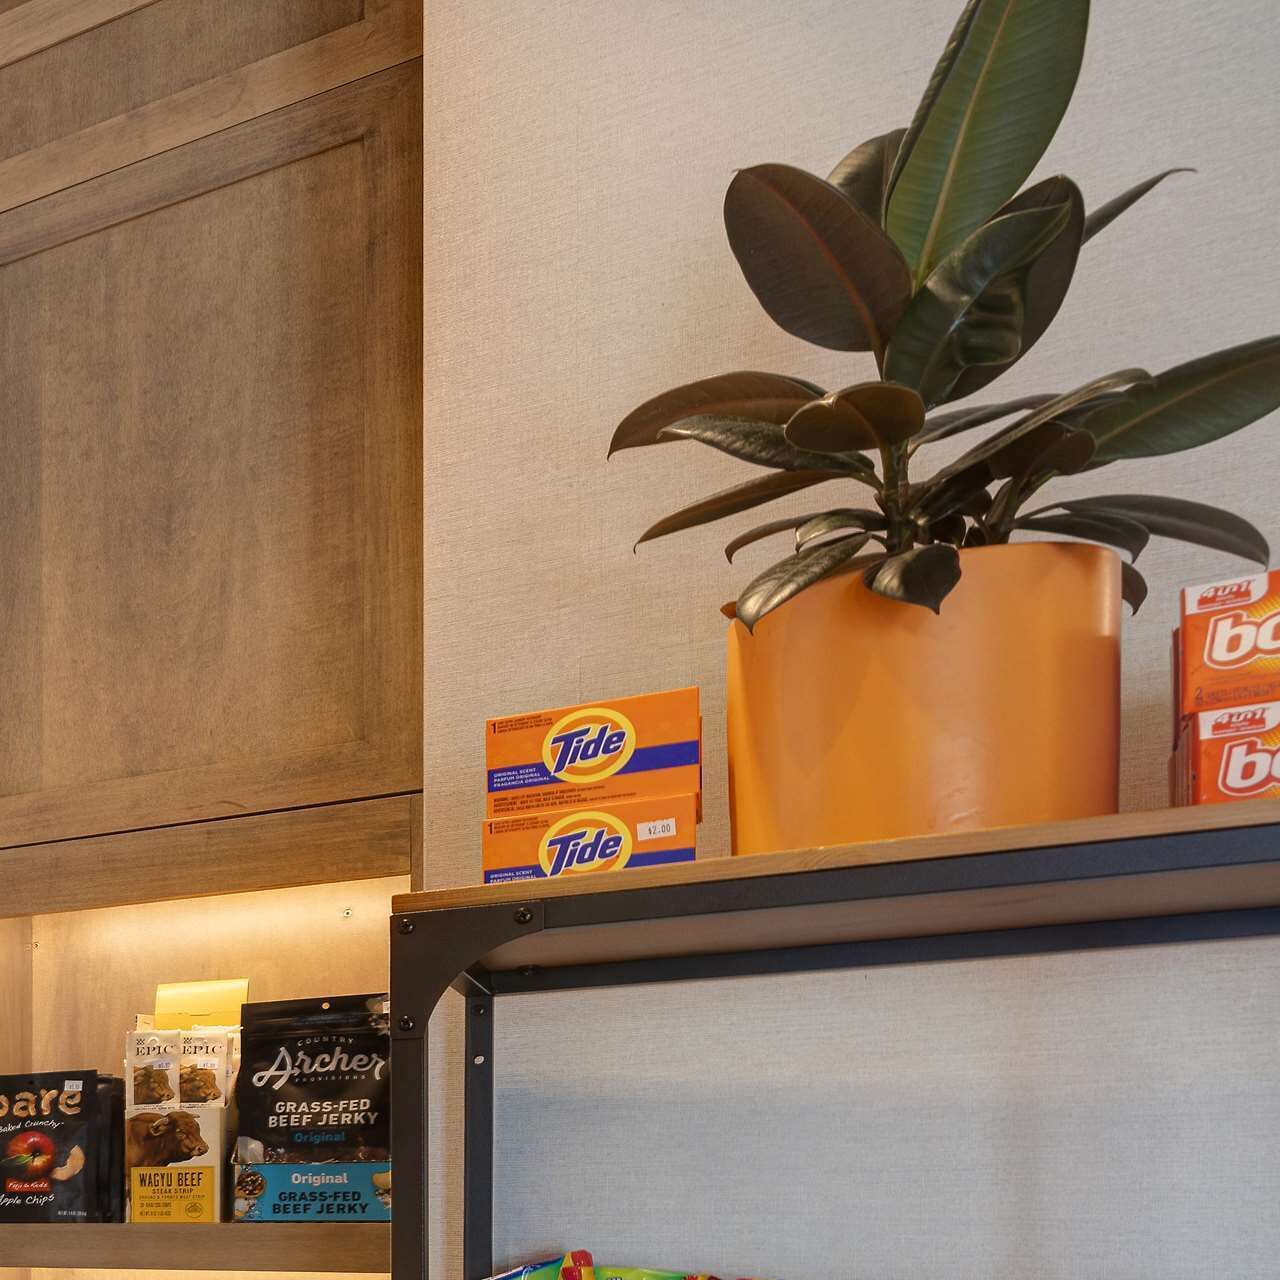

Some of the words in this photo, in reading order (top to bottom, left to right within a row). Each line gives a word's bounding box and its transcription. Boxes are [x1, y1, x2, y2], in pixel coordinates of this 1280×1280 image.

[550, 723, 627, 776] Tide
[494, 769, 518, 778] ORIGINAL
[494, 775, 514, 783] PARFUM
[515, 772, 540, 780] ORIGINAL
[494, 779, 524, 788] FRAGANCIA
[524, 776, 550, 785] ORIGINAL
[648, 823, 671, 835] $2.00
[547, 826, 623, 878] Tide
[490, 871, 515, 879] ORIGINAL
[296, 1036, 354, 1047] COUNTRY
[135, 1045, 171, 1057] EPIC
[182, 1044, 218, 1056] EPIC
[252, 1046, 386, 1090] Archer
[275, 1099, 372, 1114] GRASS-FED
[24, 1119, 61, 1130] Crunchy
[268, 1113, 313, 1128] BEEF
[318, 1112, 379, 1126] JERKY
[294, 1131, 346, 1144] Original
[139, 1172, 173, 1187] WAGYU
[177, 1172, 204, 1187] BEEF
[291, 1172, 349, 1187] Original
[25, 1193, 55, 1206] Chips
[278, 1190, 361, 1202] GRASS-FED
[272, 1202, 311, 1214] BEEF
[316, 1202, 369, 1215] JERKY
